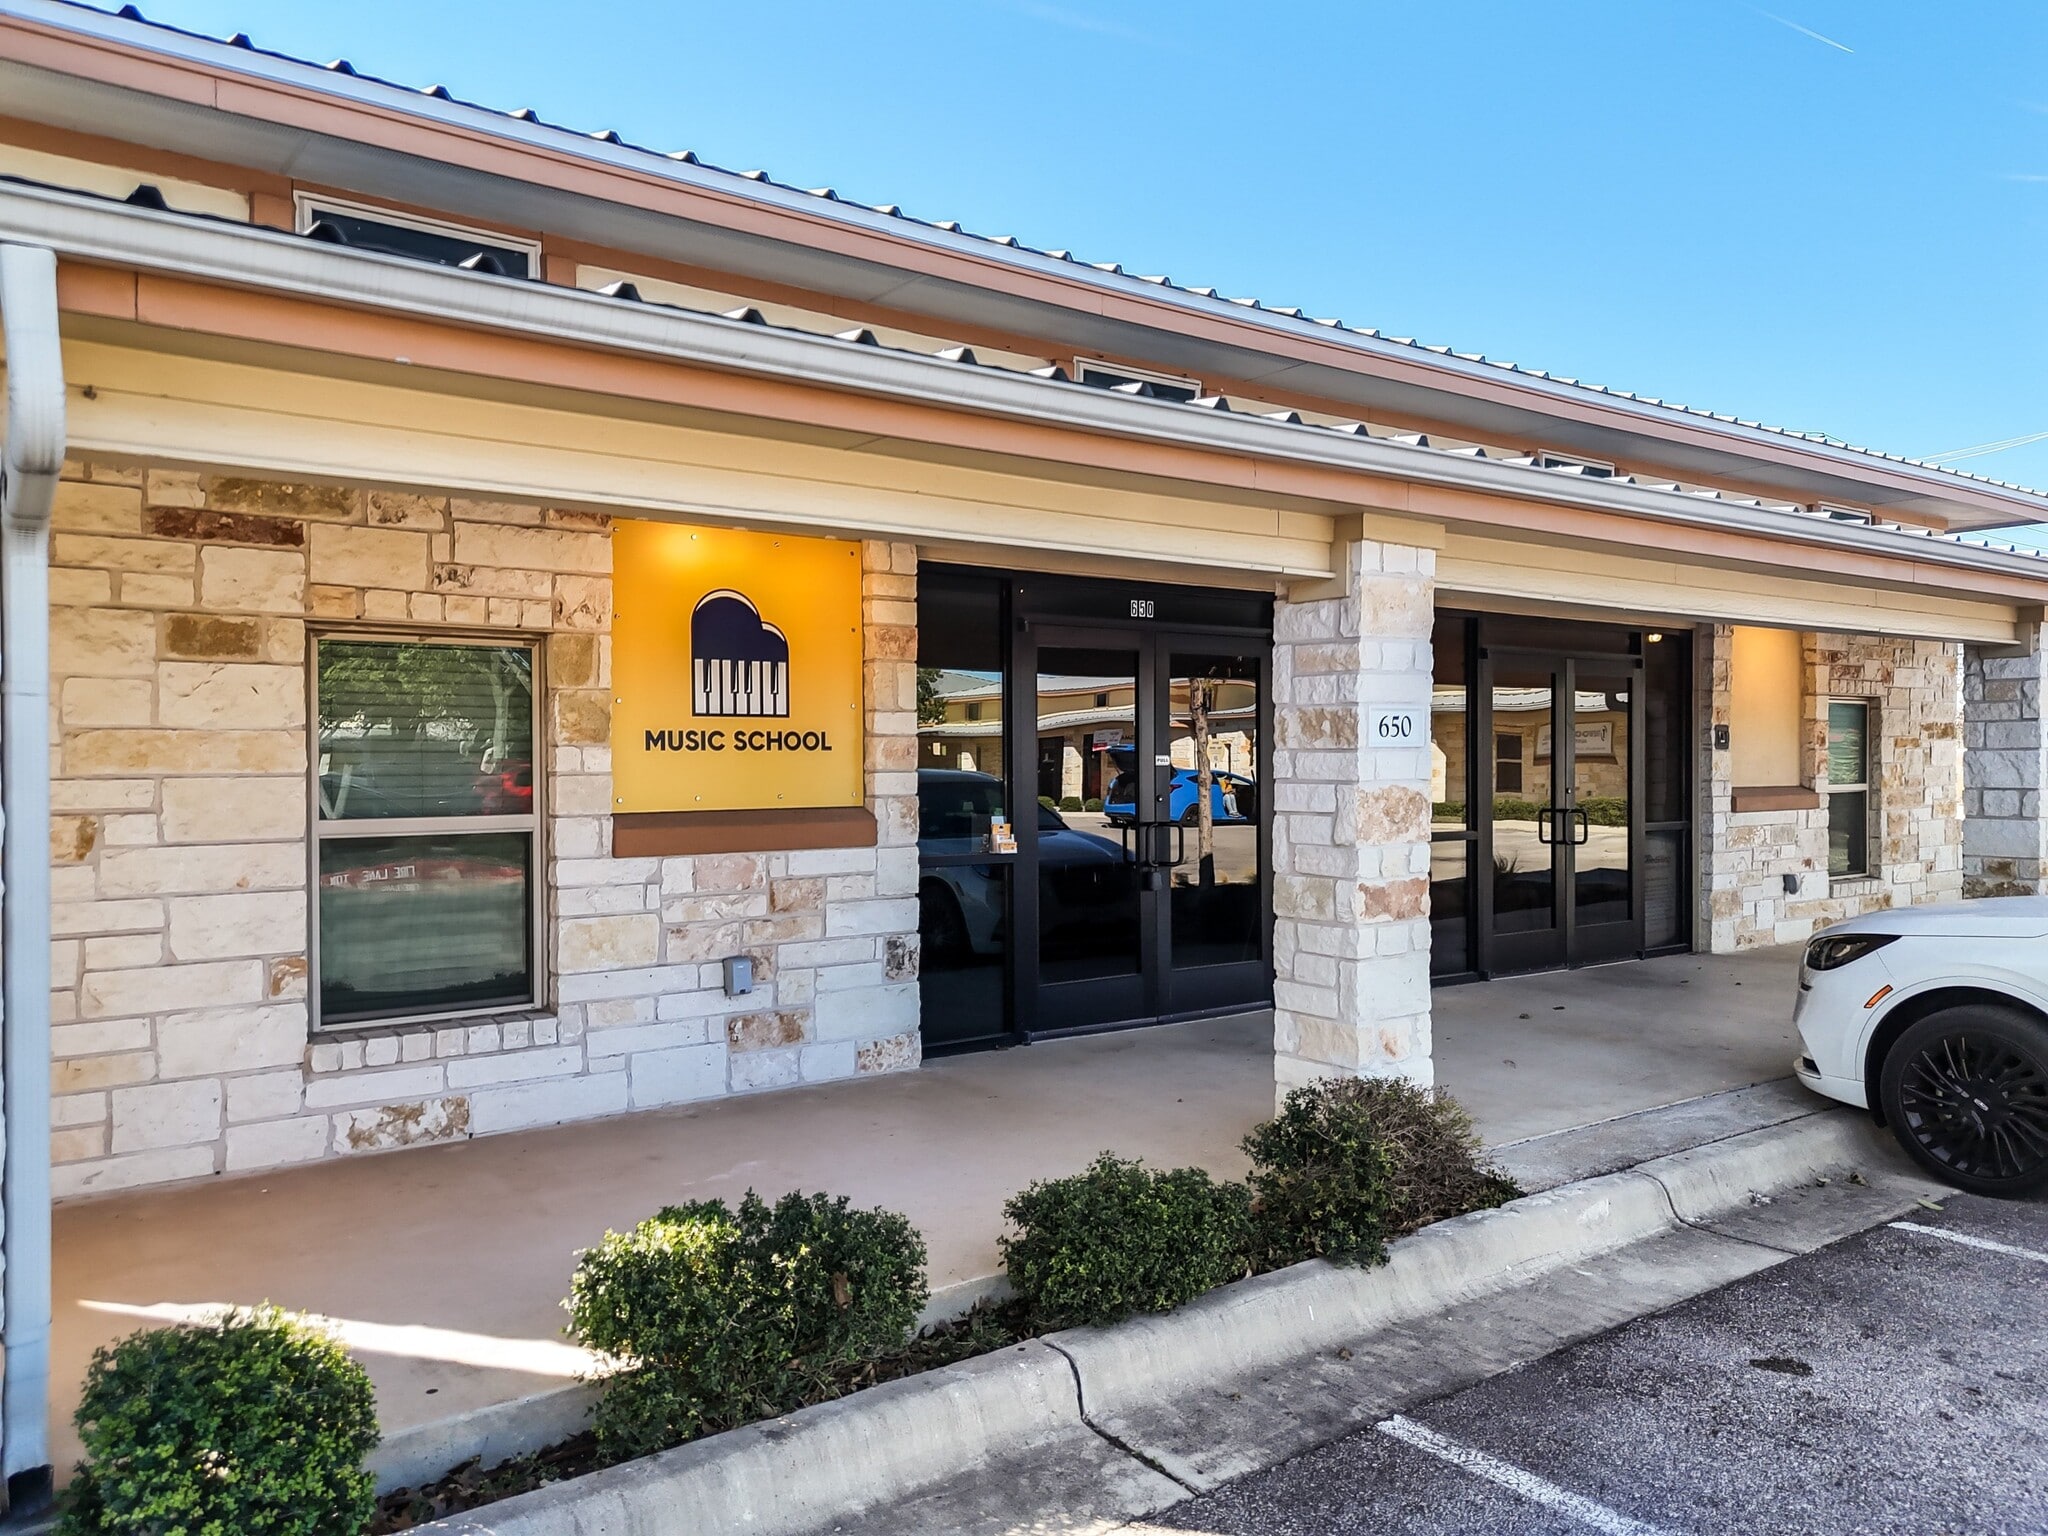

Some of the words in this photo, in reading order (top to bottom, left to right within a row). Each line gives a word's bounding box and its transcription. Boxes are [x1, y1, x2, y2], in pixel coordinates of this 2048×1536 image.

[1130, 600, 1154, 618] 650
[1378, 715, 1412, 738] 650
[645, 730, 726, 751] MUSIC
[733, 730, 833, 751] SCHOOL
